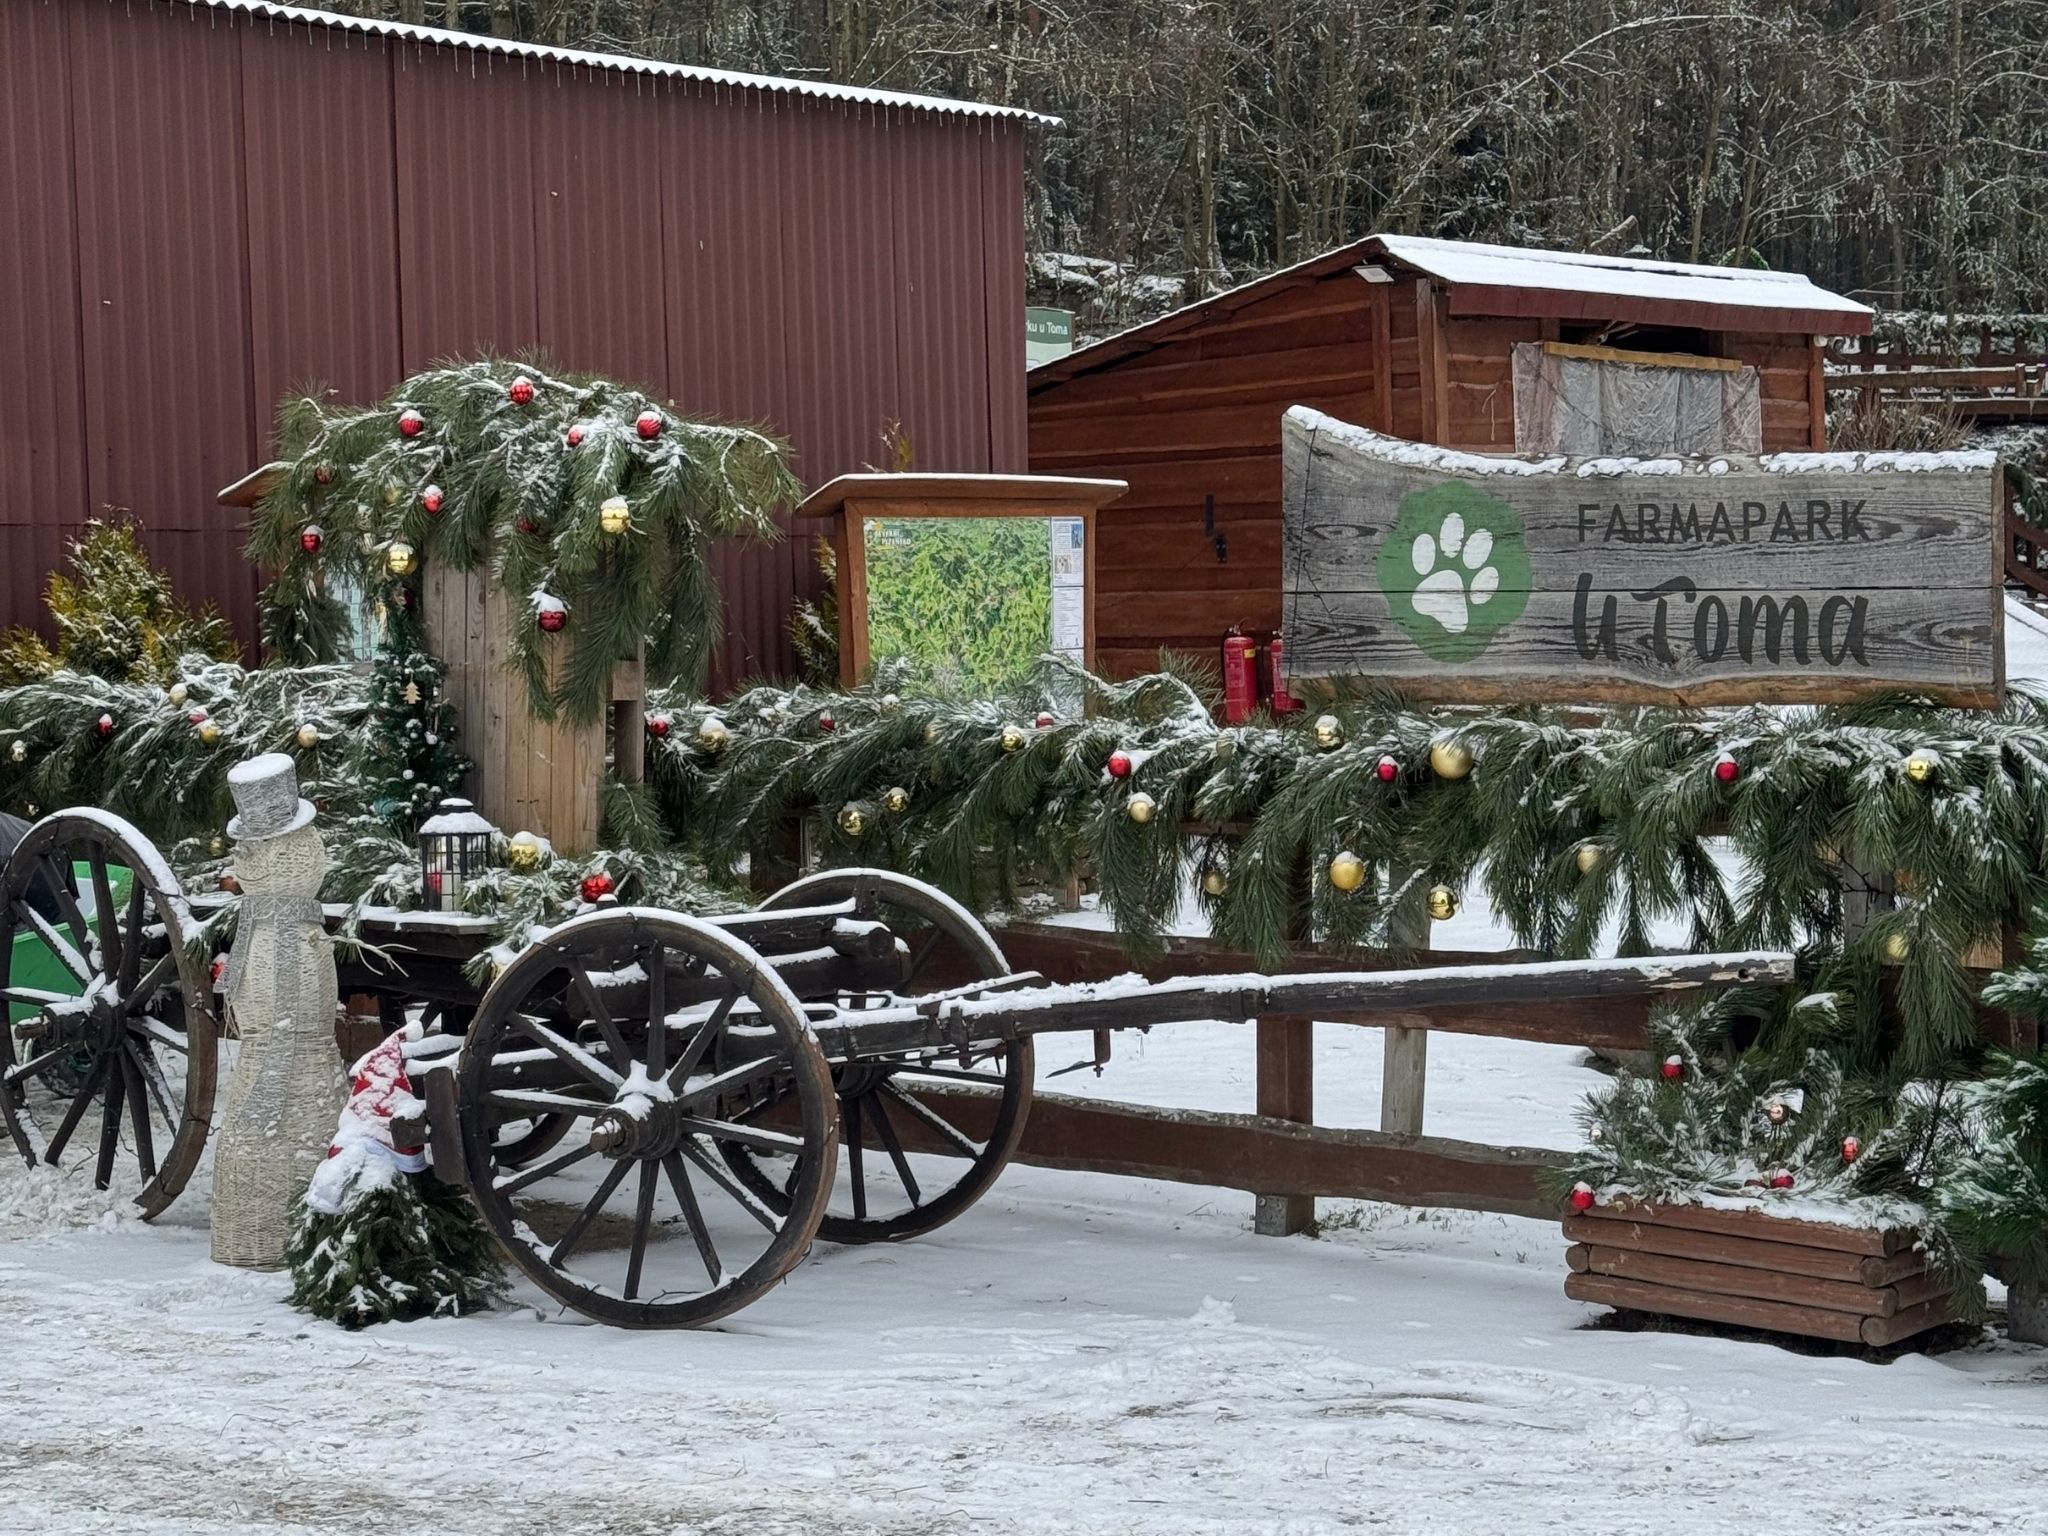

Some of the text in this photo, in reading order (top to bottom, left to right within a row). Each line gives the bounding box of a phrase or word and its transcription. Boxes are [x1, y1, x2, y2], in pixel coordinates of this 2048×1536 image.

[1025, 319, 1069, 336] ku u Toma
[1578, 500, 1871, 543] FARMAPARK
[1630, 575, 1870, 667] Toma
